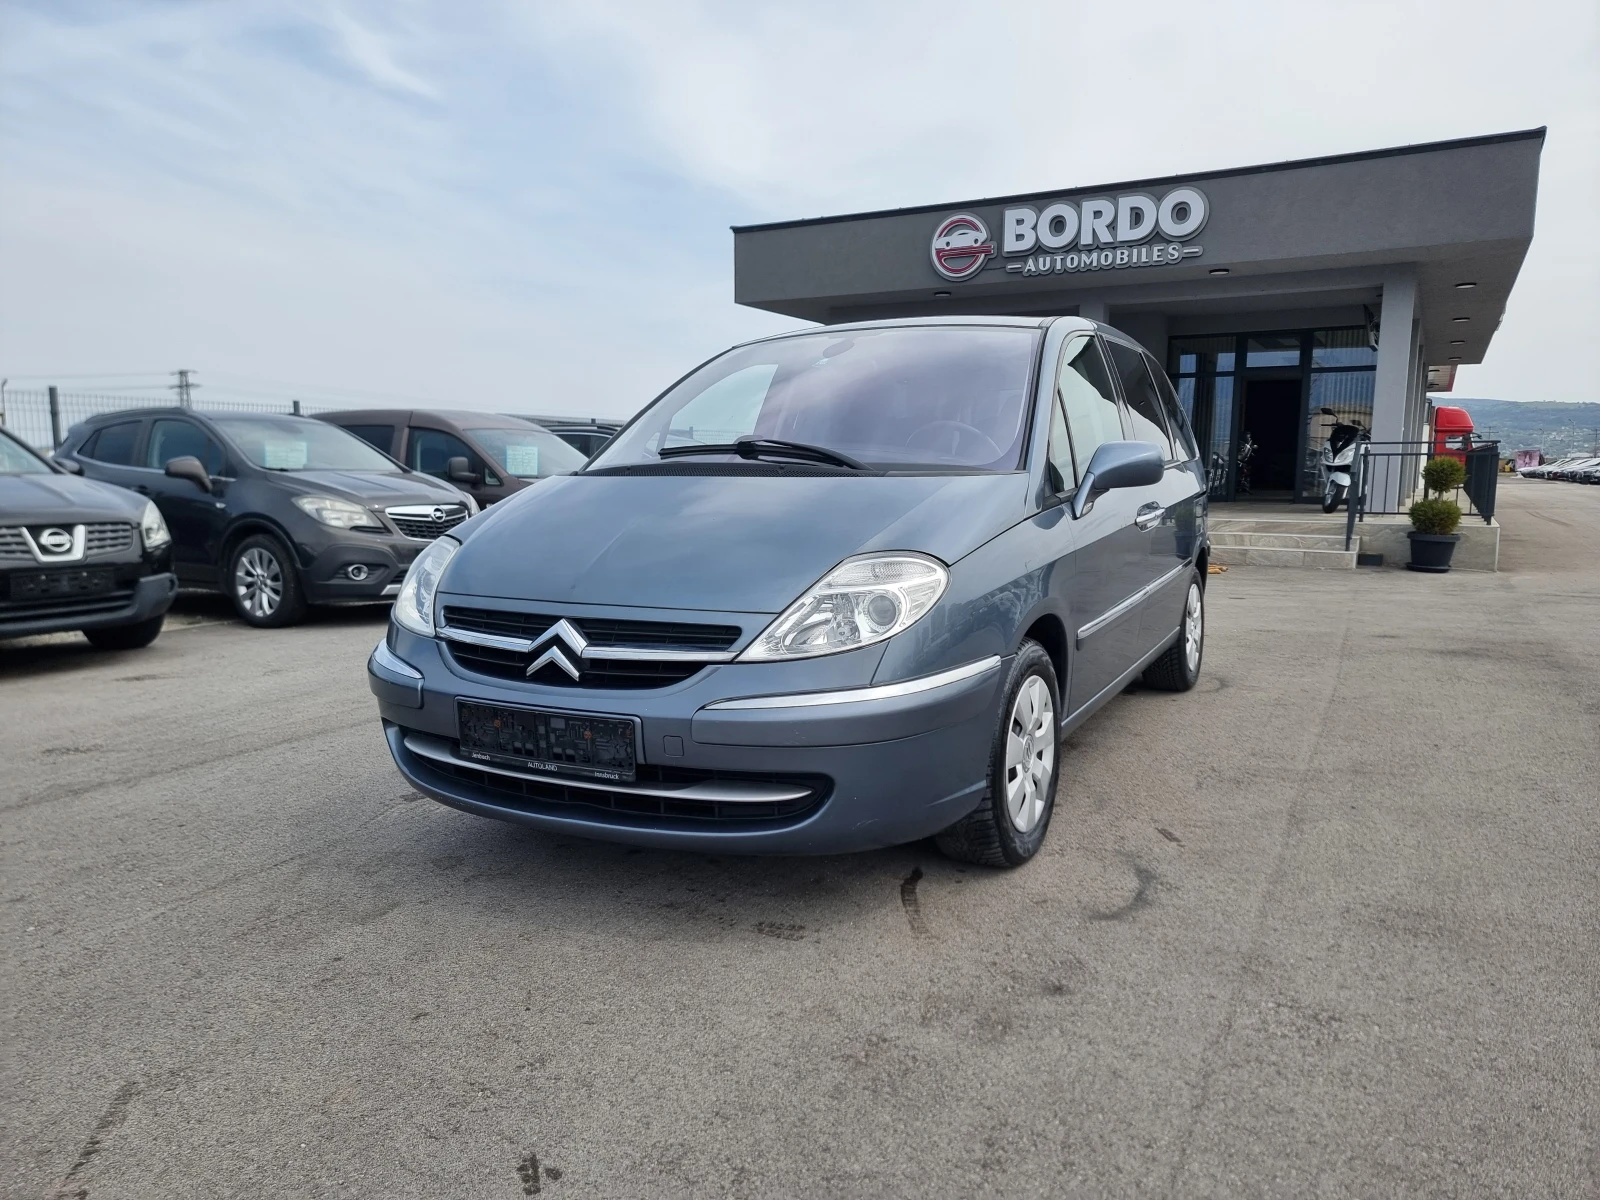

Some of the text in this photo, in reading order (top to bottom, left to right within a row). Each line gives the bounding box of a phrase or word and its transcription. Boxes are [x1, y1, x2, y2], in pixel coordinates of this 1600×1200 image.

[1004, 189, 1205, 253] BORDO
[1024, 245, 1180, 273] AUTOMOBILES
[527, 761, 558, 771] AUTOLAND
[594, 771, 620, 780] Innsbruck
